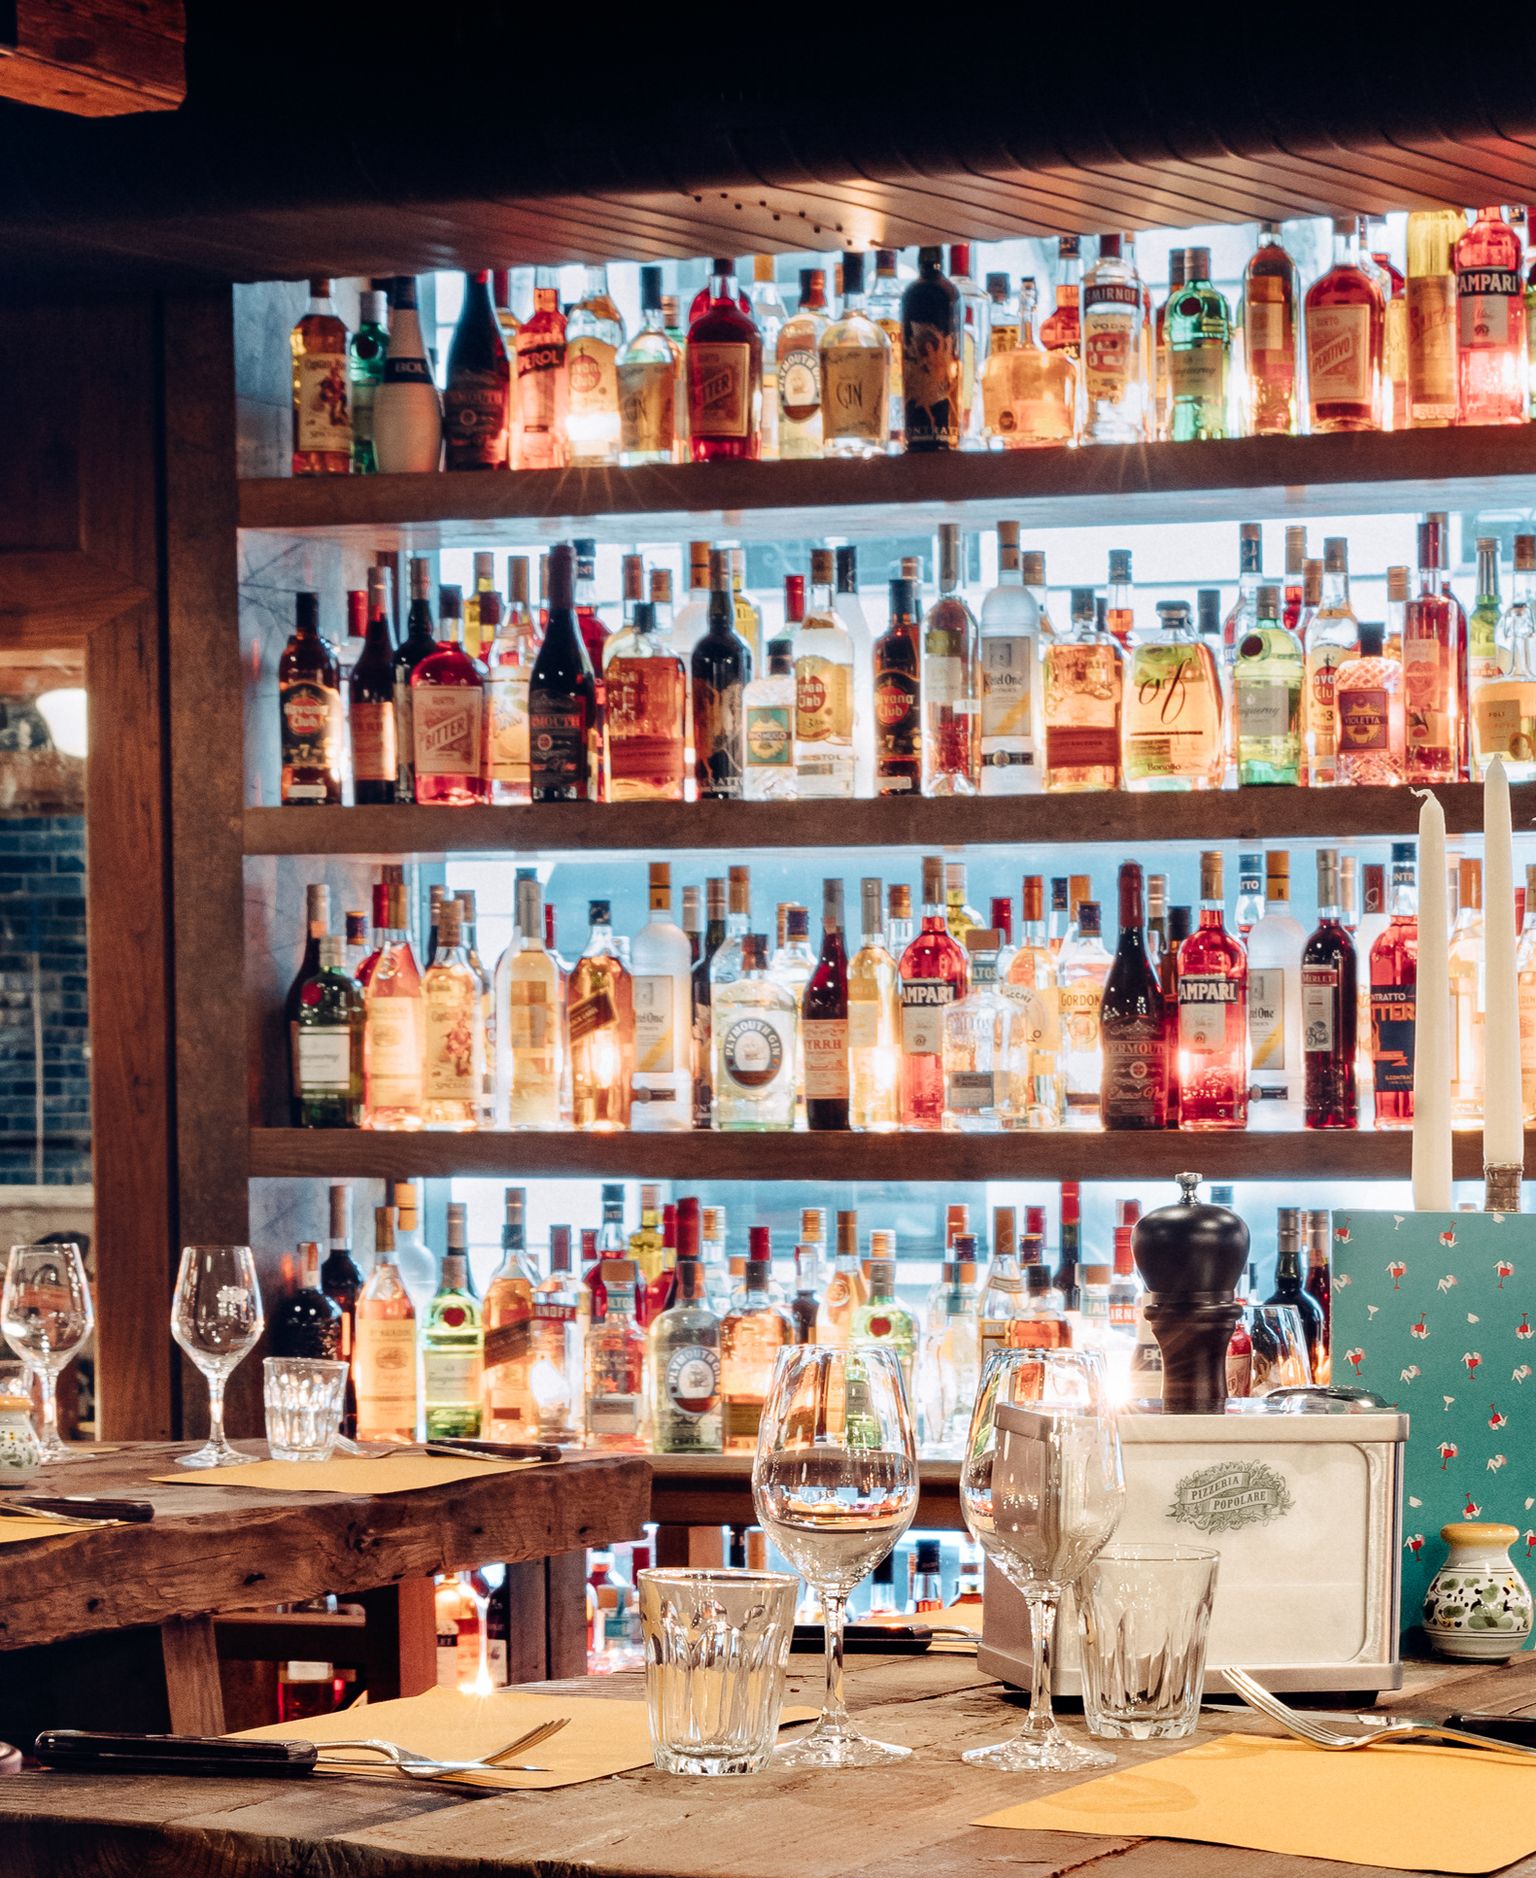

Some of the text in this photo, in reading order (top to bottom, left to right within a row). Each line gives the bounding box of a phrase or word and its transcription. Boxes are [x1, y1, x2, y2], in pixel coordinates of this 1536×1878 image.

[1315, 687, 1335, 700] Clu
[1344, 715, 1381, 726] VIOLETTA
[424, 718, 467, 749] BITTER
[1060, 993, 1100, 1008] GORDON
[725, 1020, 782, 1056] PLYMOUTH GIN
[806, 1039, 843, 1050] YRRH
[668, 1349, 716, 1385] PLYMOUTH
[1191, 1475, 1240, 1501] PIZZERIA
[1213, 1490, 1267, 1511] POPOLARE
